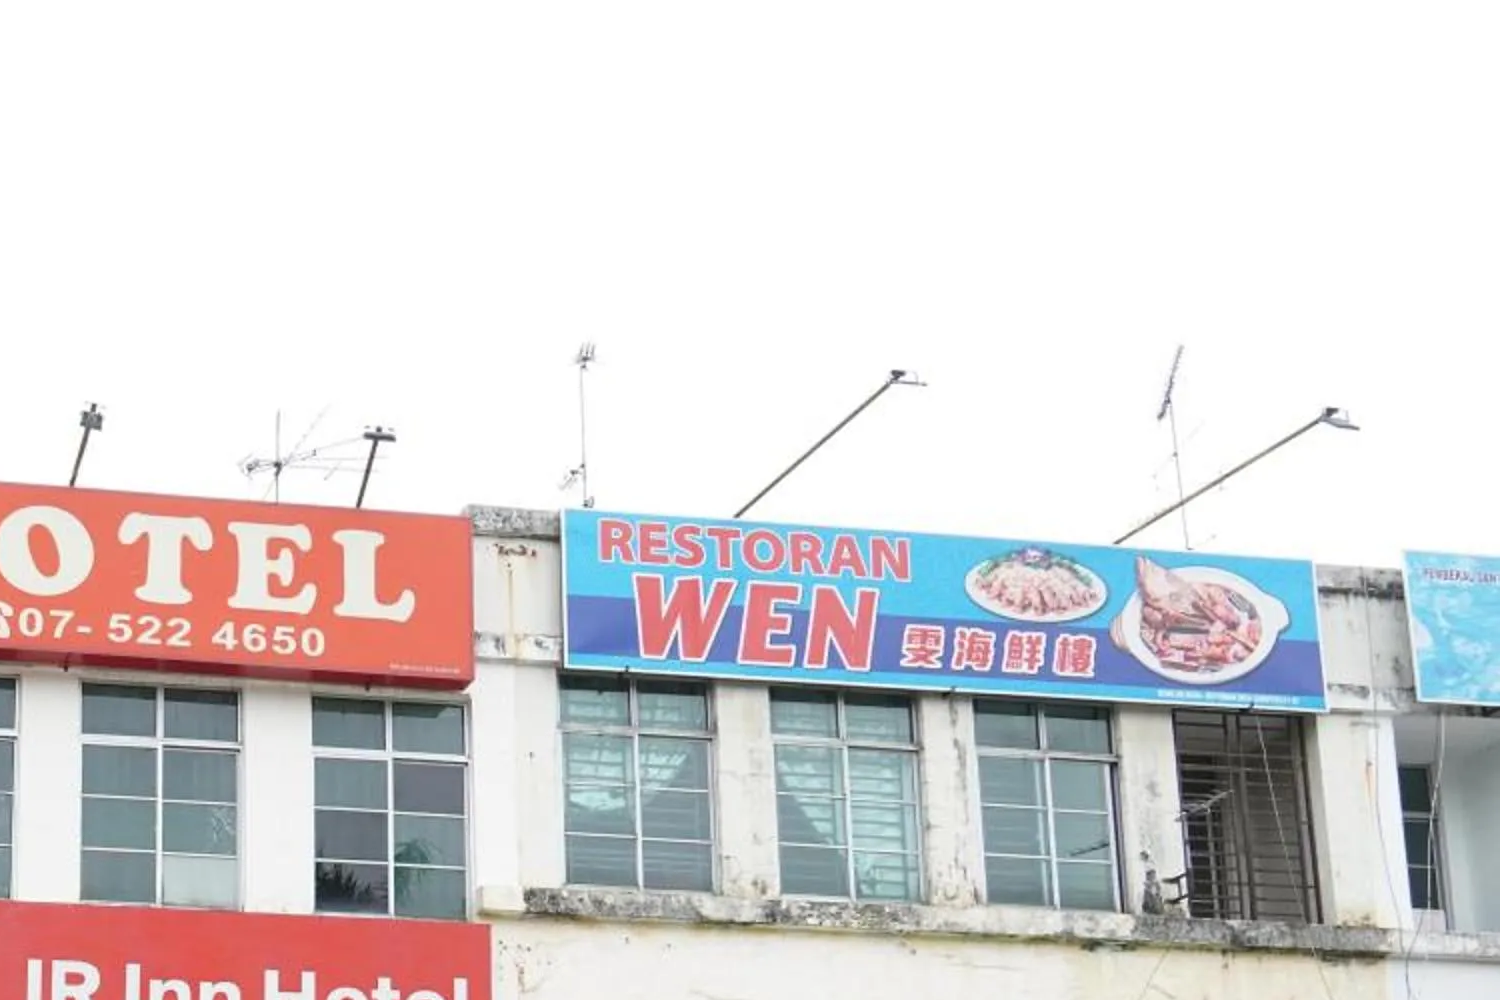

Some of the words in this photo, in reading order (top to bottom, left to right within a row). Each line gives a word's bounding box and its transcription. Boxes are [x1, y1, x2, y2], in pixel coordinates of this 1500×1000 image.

[598, 518, 912, 583] RESTORAN
[18, 607, 92, 639] 07-
[108, 613, 192, 648] 522
[212, 621, 326, 657] 4650
[632, 574, 880, 672] WEN
[900, 624, 1097, 678] 雯海鮮樓
